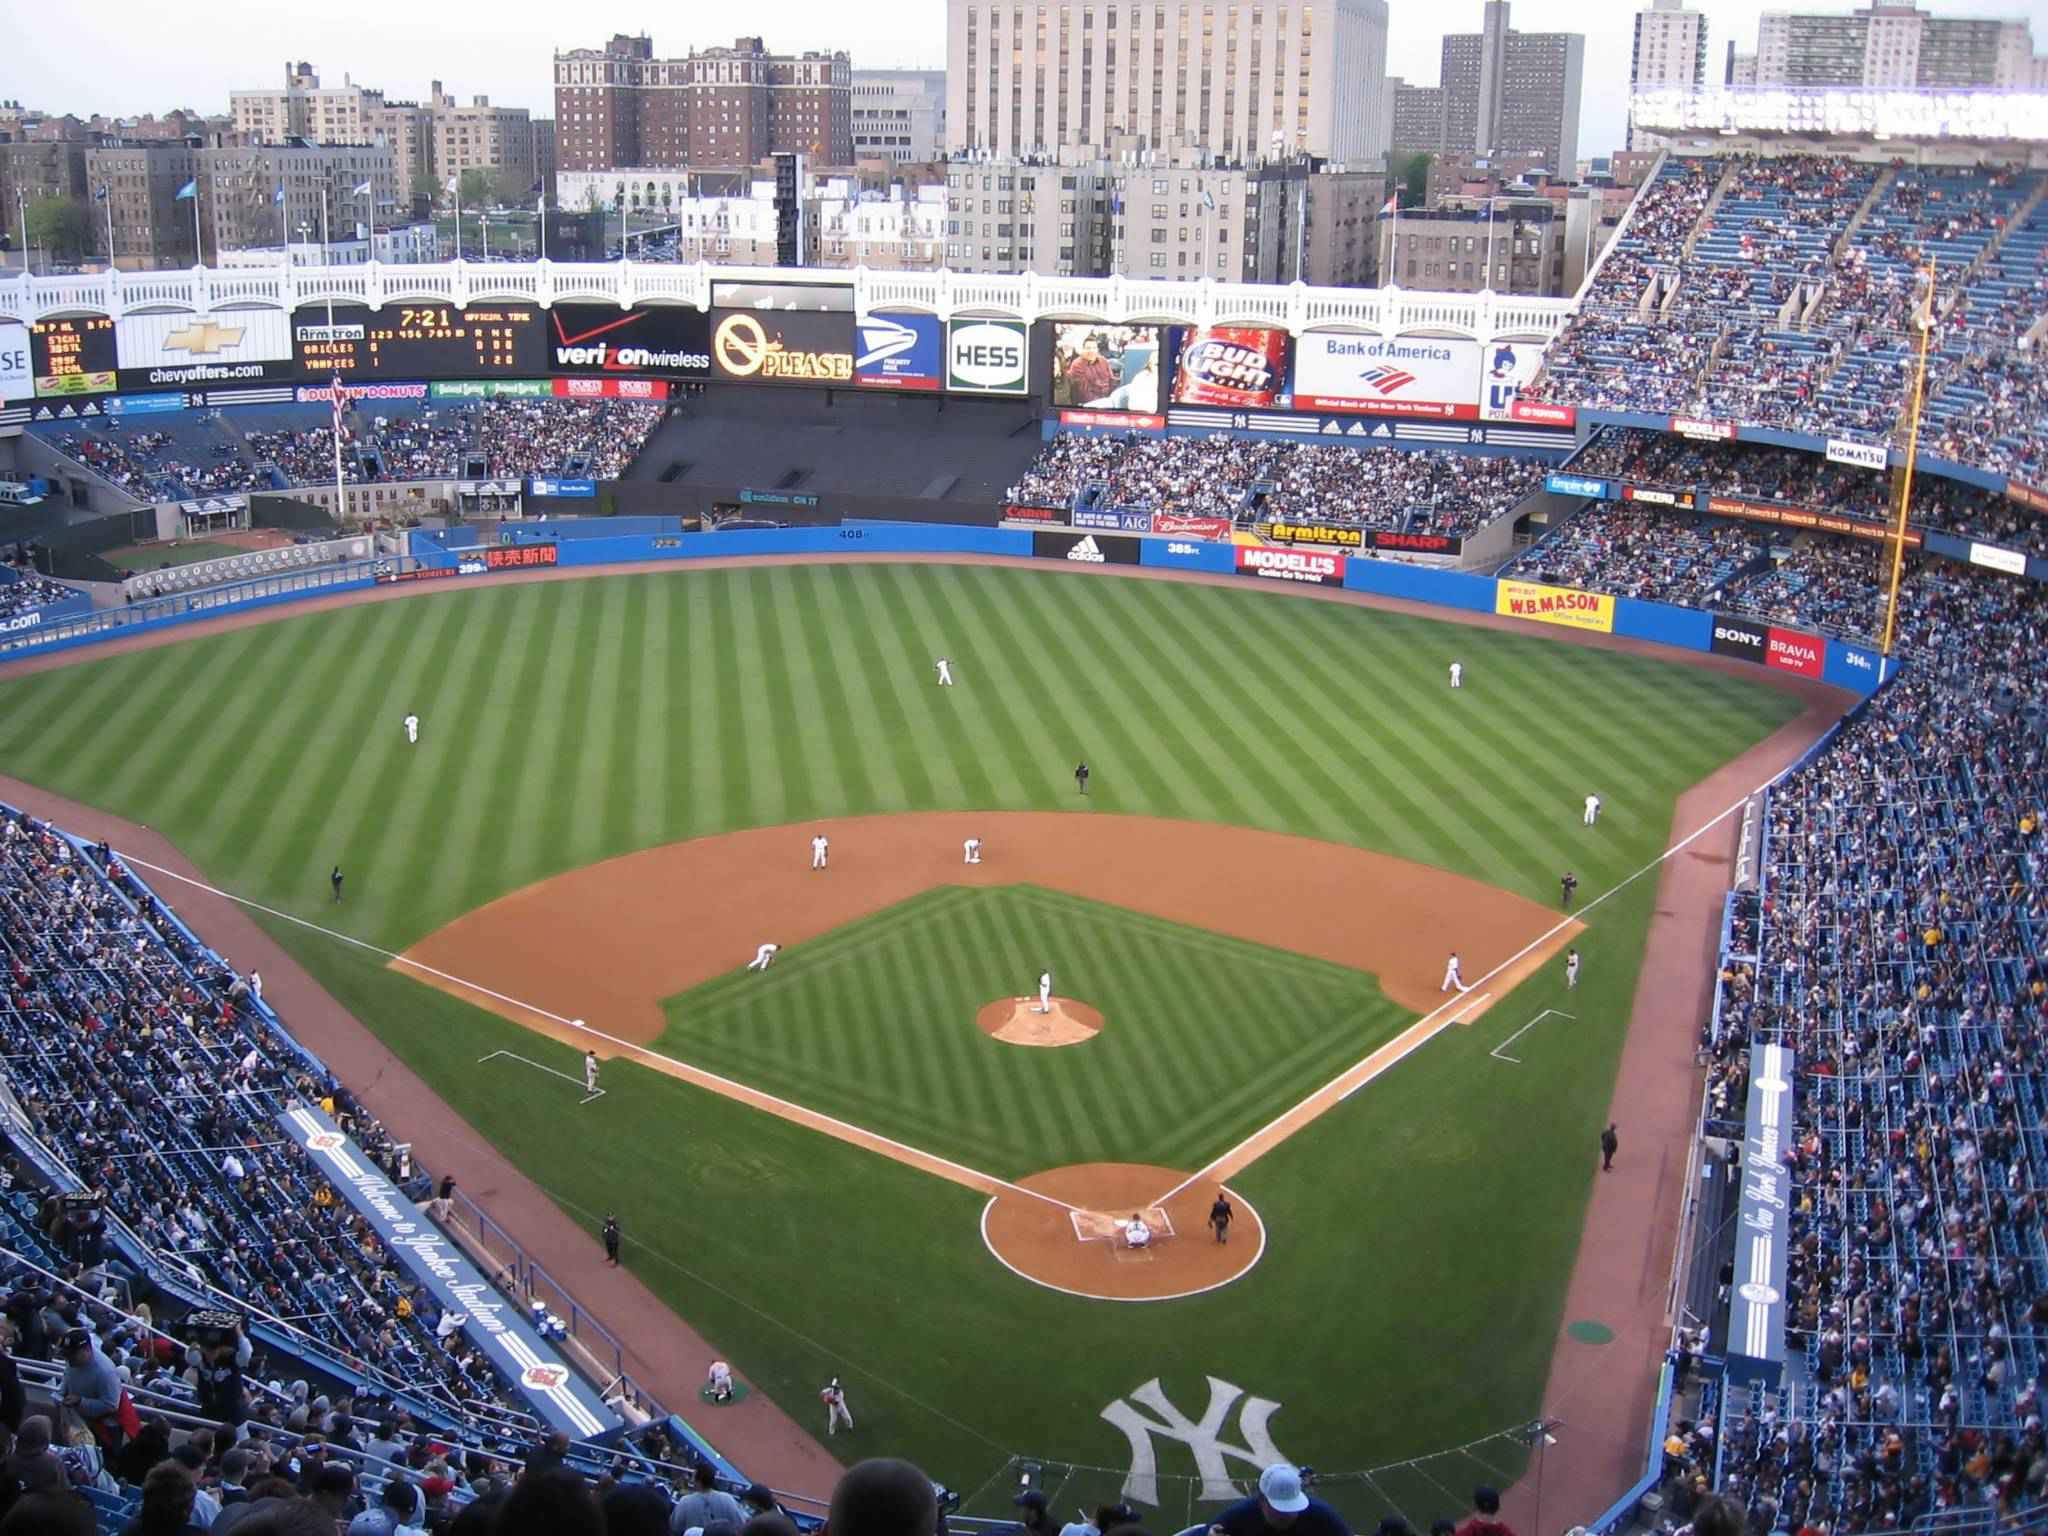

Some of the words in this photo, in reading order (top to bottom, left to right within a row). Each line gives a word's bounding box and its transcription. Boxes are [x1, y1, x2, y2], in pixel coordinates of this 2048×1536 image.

[401, 309, 449, 326] 7:21
[300, 328, 361, 340] Armtron
[556, 342, 650, 370] verizon
[649, 350, 710, 368] wireless
[956, 345, 1018, 368] HESS
[1202, 343, 1267, 369] BUD
[1327, 340, 1365, 355] Bank
[1368, 342, 1383, 356] of
[1386, 343, 1451, 360] America
[150, 365, 264, 384] chevyoffers.com
[763, 351, 853, 379] PLEASE!
[1190, 356, 1272, 386] LIGHT
[367, 386, 427, 399] DONUTS
[1829, 445, 1883, 464] KOMATSU
[1122, 516, 1148, 530] AIG
[1272, 524, 1361, 543] Armitron
[1375, 531, 1449, 548] SHARP
[1067, 551, 1104, 562] adidas
[1243, 550, 1336, 576] MODELL'S
[1714, 627, 1761, 647] SONY
[1769, 639, 1817, 662] BRAVIA
[352, 1174, 404, 1222] Welcome
[1745, 1170, 1785, 1210] York
[392, 1222, 416, 1234] to
[390, 1233, 461, 1279] Yankee
[446, 1279, 506, 1335] Stadium
